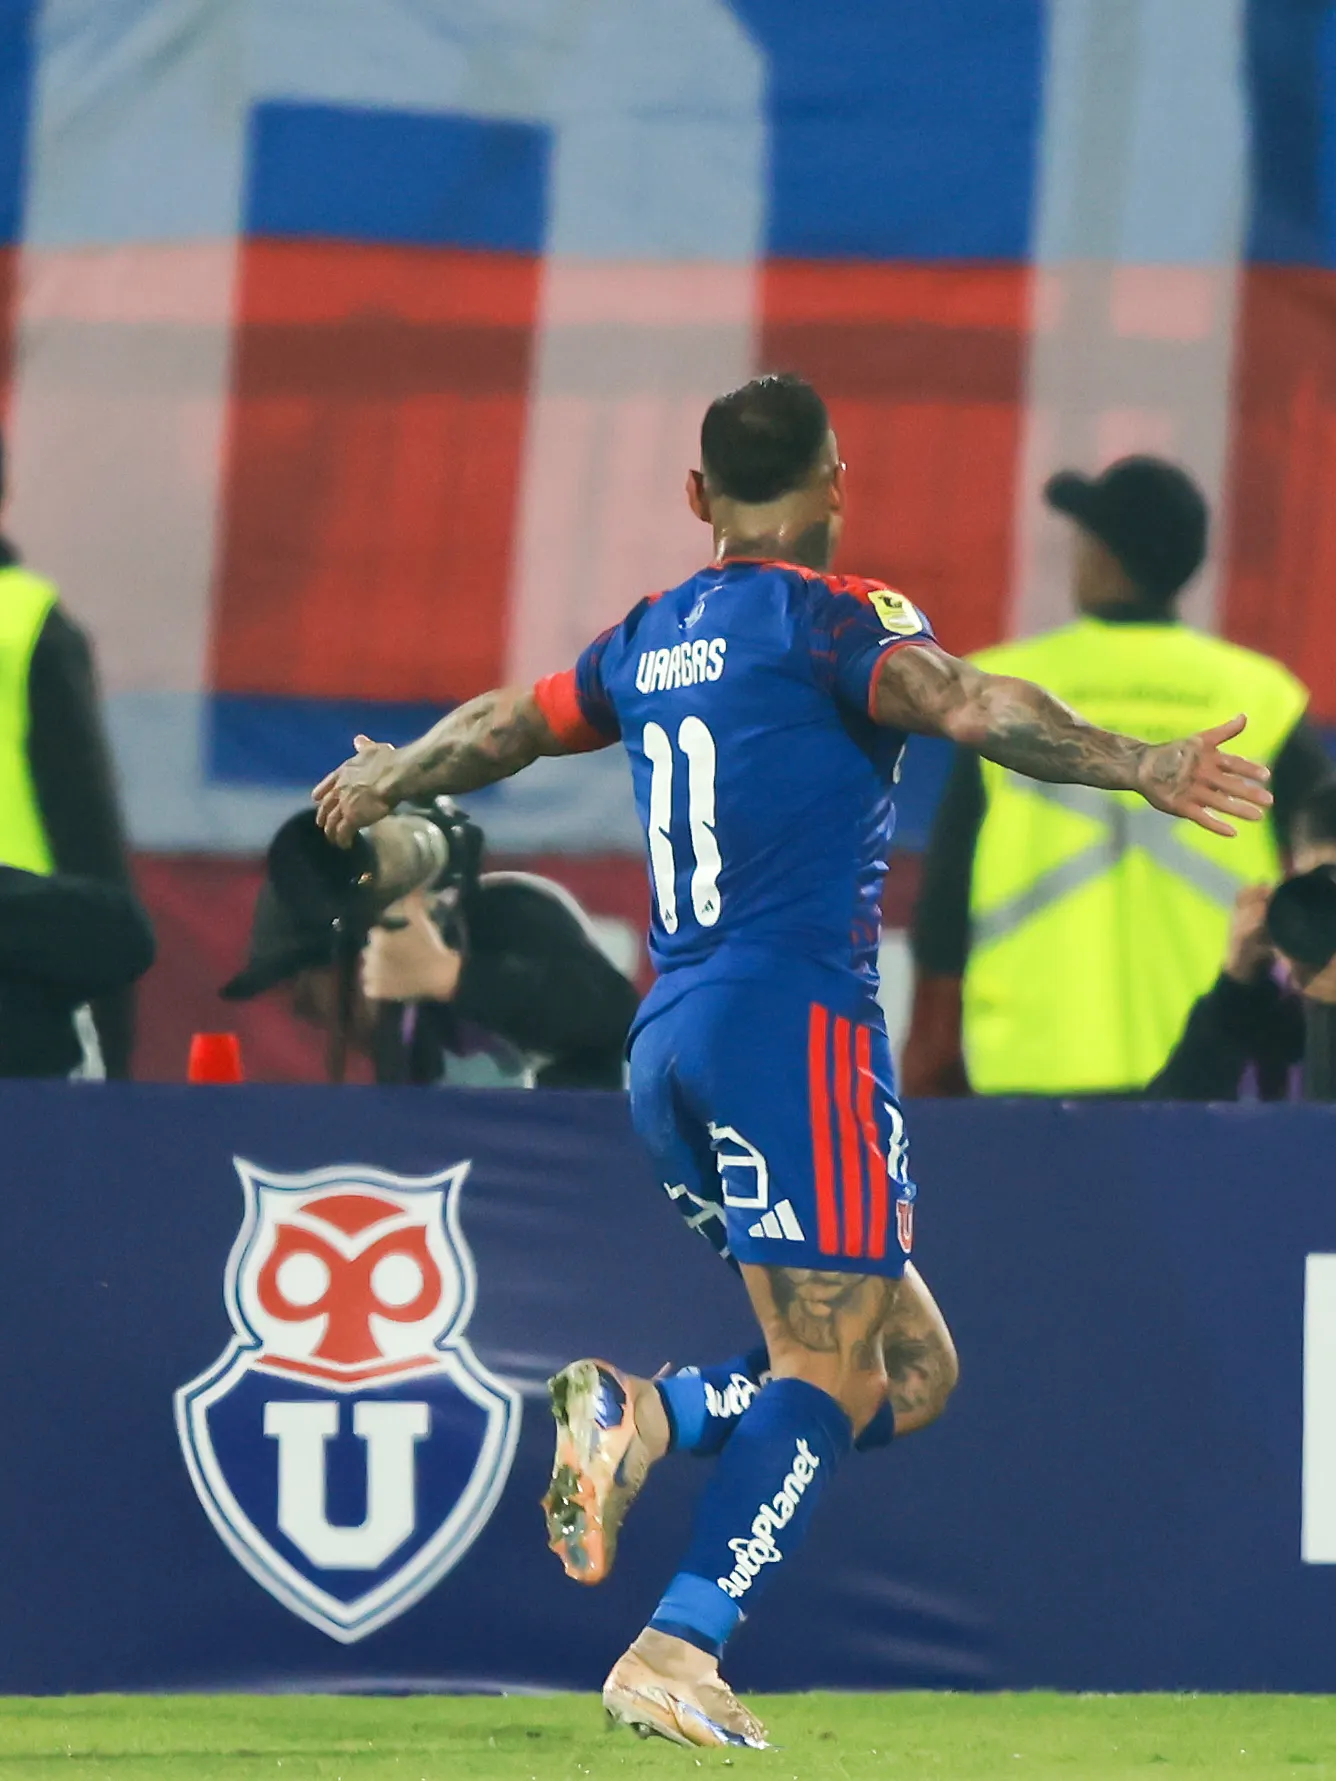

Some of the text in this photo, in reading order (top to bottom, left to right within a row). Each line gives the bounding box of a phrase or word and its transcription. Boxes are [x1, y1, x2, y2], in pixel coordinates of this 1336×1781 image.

[635, 637, 727, 694] VARGAS
[642, 715, 722, 935] 11
[263, 1400, 430, 1569] U
